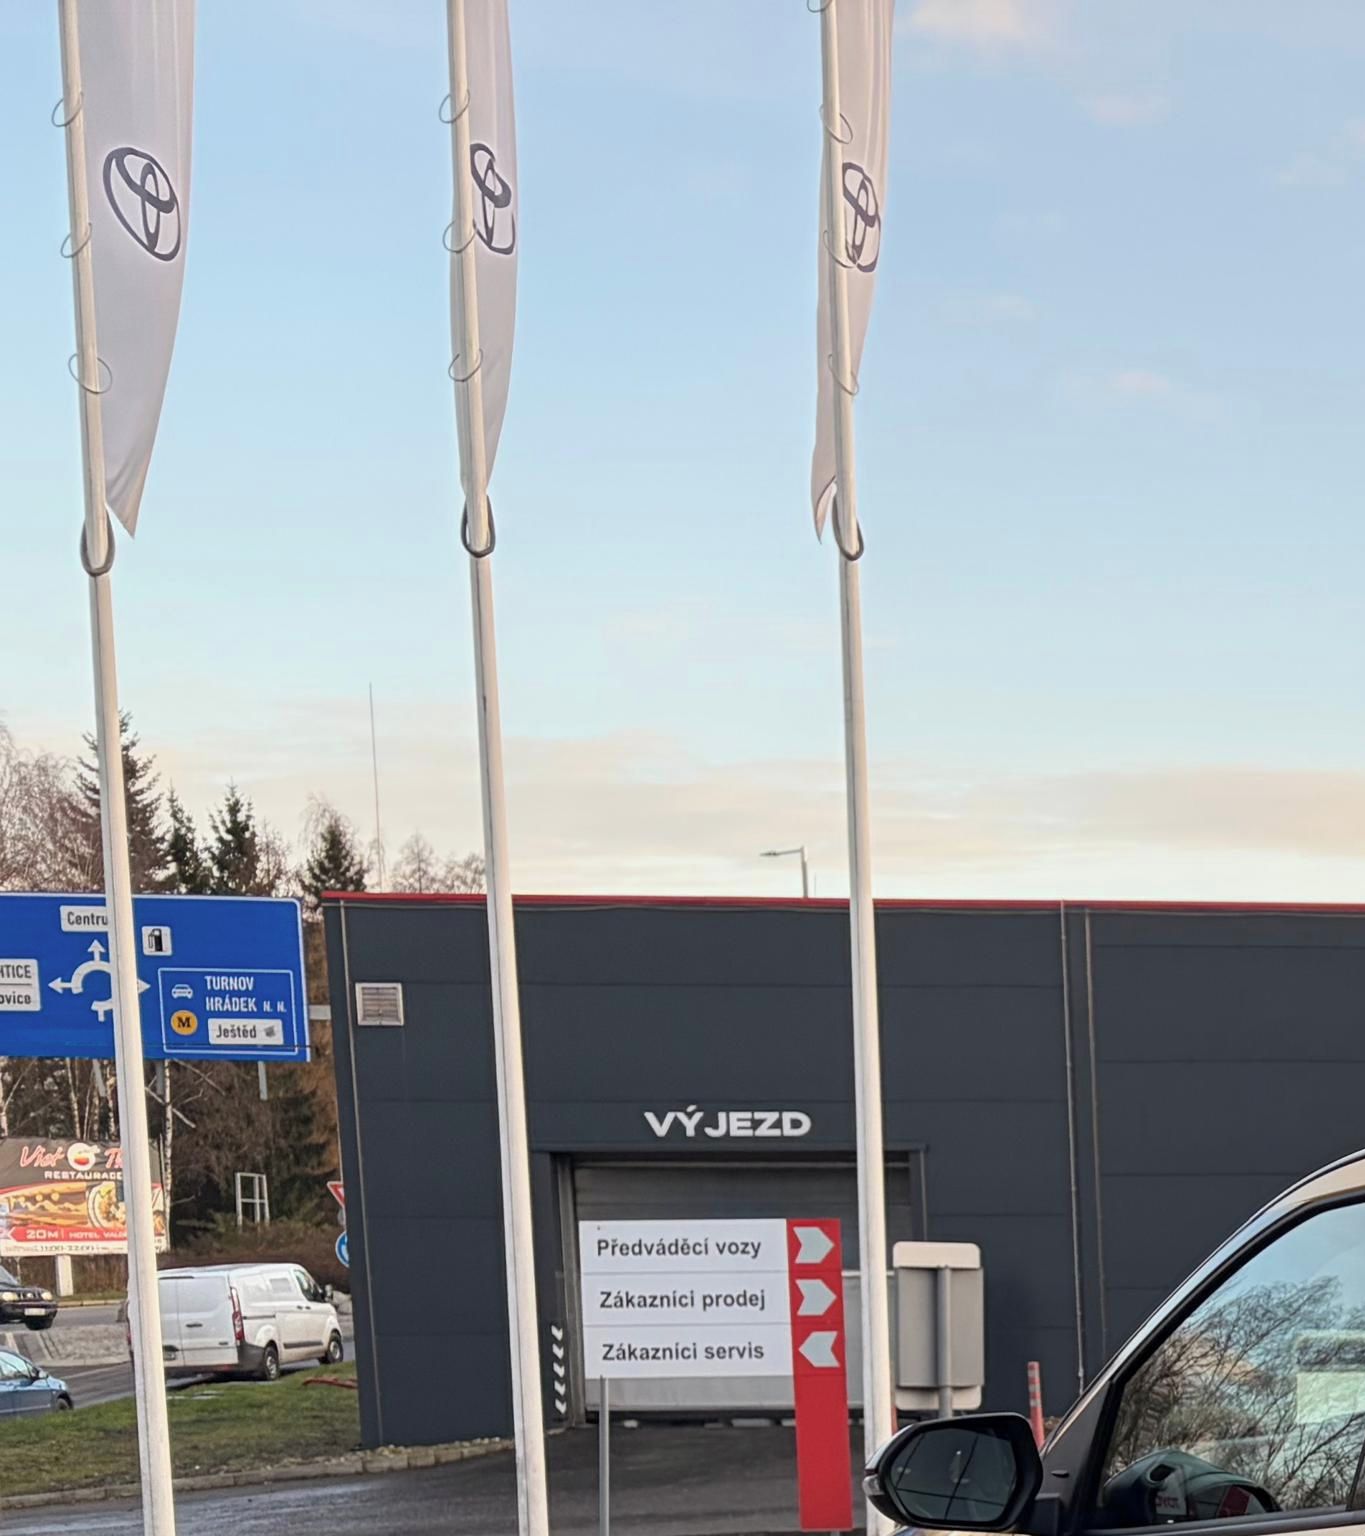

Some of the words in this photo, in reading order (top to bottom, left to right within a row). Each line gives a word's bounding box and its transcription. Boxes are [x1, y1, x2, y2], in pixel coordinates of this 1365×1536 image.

[67, 911, 108, 926] Centru
[204, 976, 254, 991] TURNOV
[205, 994, 257, 1012] HRÁDEK
[263, 1001, 273, 1013] N.
[277, 1001, 287, 1013] N.
[216, 1024, 257, 1039] Ještěd
[643, 1105, 812, 1138] VÝJEZD
[597, 1237, 709, 1257] Předváděcí
[716, 1241, 762, 1259] vozy
[599, 1290, 695, 1309] Zákazníci
[702, 1289, 766, 1311] prodej
[602, 1342, 698, 1361] Zákazníci
[704, 1342, 764, 1360] servis
